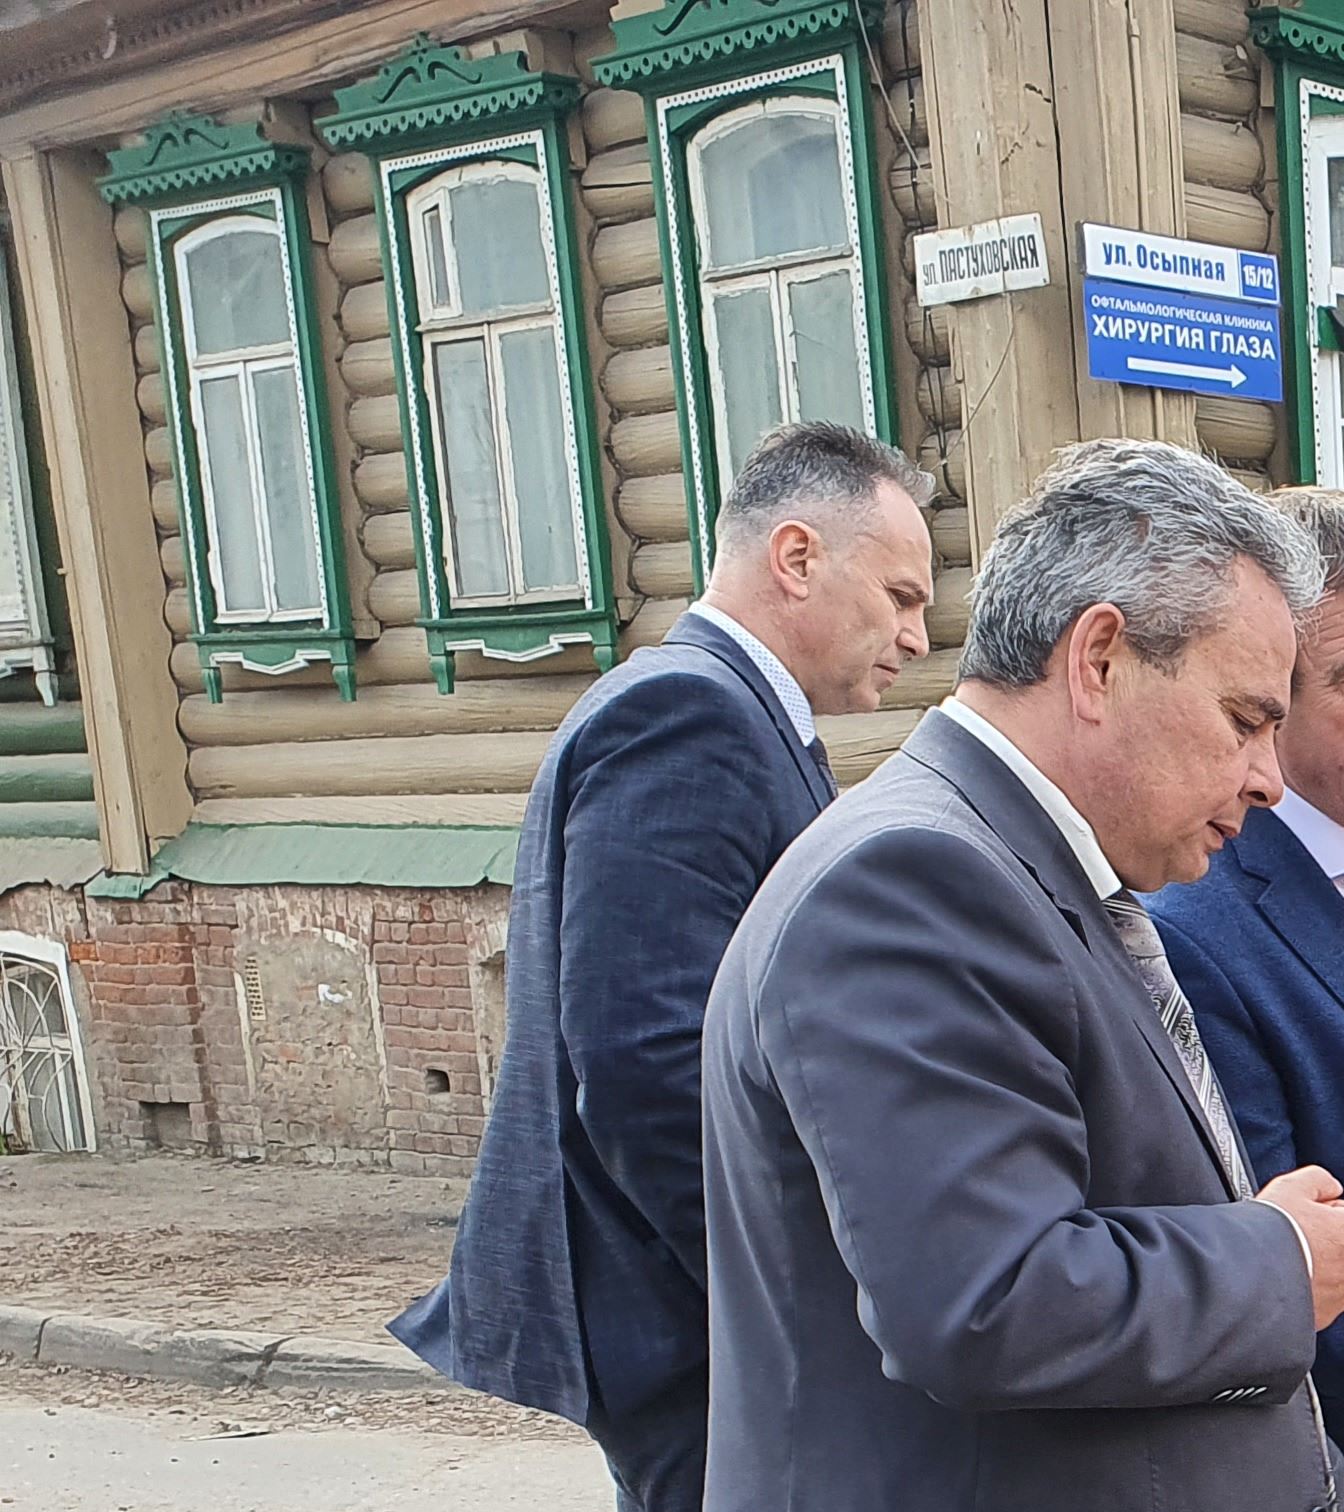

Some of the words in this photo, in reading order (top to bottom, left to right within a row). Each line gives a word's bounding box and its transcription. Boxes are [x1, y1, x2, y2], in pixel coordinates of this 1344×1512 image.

[938, 234, 1040, 284] ПАСТУХОВСКАЯ
[1103, 242, 1132, 267] ул.
[1137, 244, 1226, 281] Осыпная
[1243, 264, 1274, 290] 15/12
[1091, 294, 1223, 325] ОФТАЛЬМОЛОГИЧЕСКАЯ
[1224, 315, 1274, 333] КЛИНИКА
[1091, 313, 1204, 350] ХИРУРГИЯ
[1210, 330, 1277, 361] ГЛАЗА
